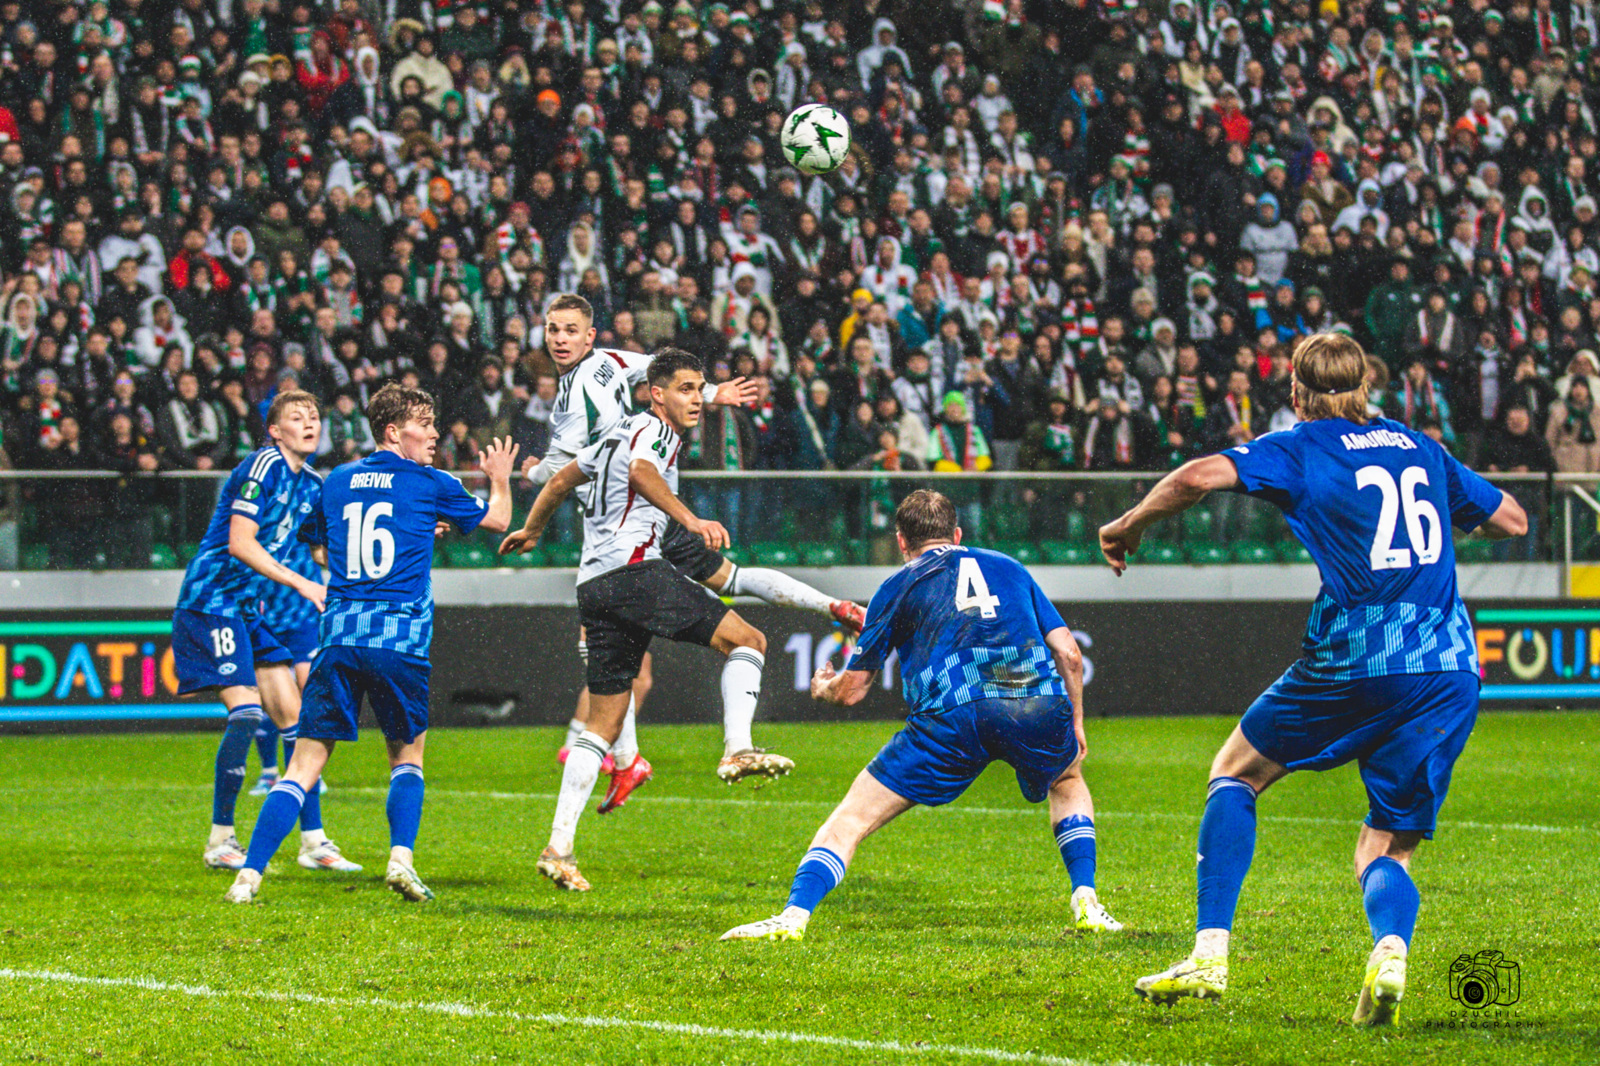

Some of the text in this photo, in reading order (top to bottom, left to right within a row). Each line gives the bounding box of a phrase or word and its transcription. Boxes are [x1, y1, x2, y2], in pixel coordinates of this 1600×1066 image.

[350, 472, 395, 489] BREIVIK
[342, 501, 395, 579] 16
[1355, 465, 1442, 571] 26
[955, 557, 1000, 618] 4
[210, 626, 236, 657] 18
[1476, 627, 1600, 679] FOU
[0, 642, 197, 699] DATI
